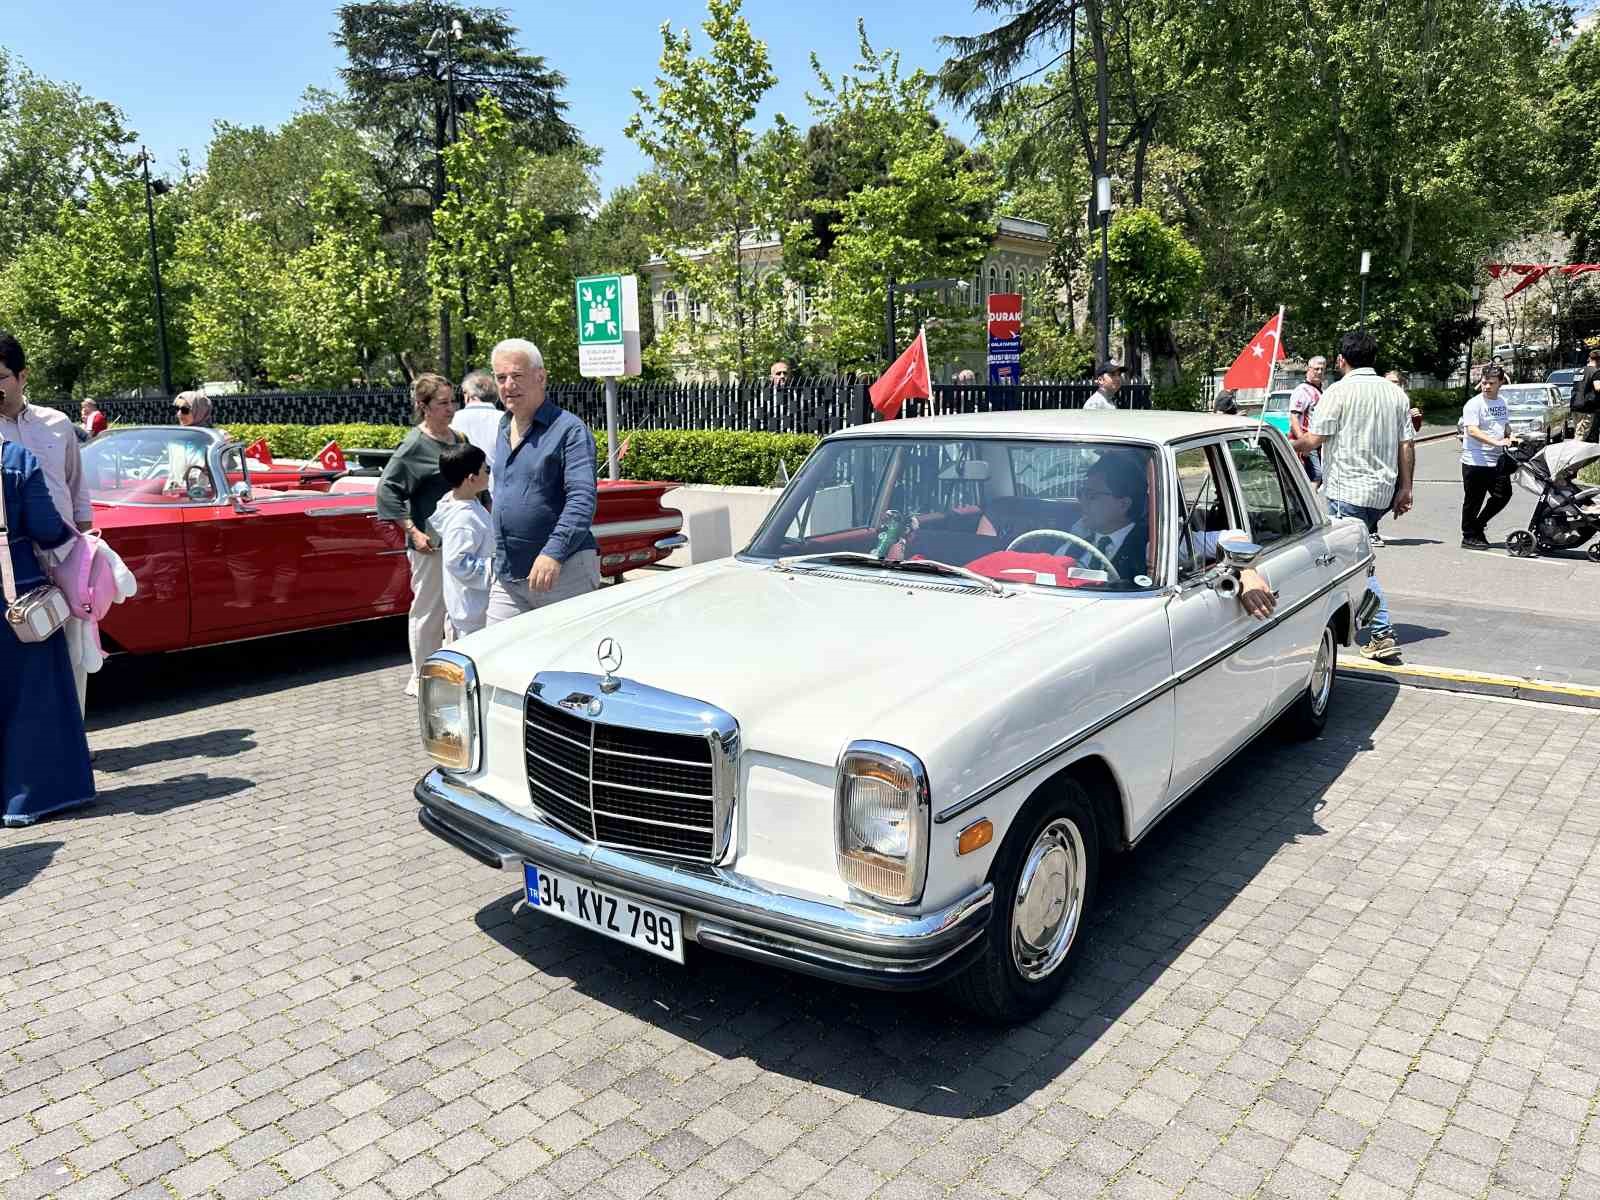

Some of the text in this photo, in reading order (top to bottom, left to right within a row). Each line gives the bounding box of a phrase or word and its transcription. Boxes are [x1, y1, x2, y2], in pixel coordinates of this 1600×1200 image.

[988, 312, 1021, 321] DURAK
[529, 873, 675, 952] TR 34 KVZ 799
